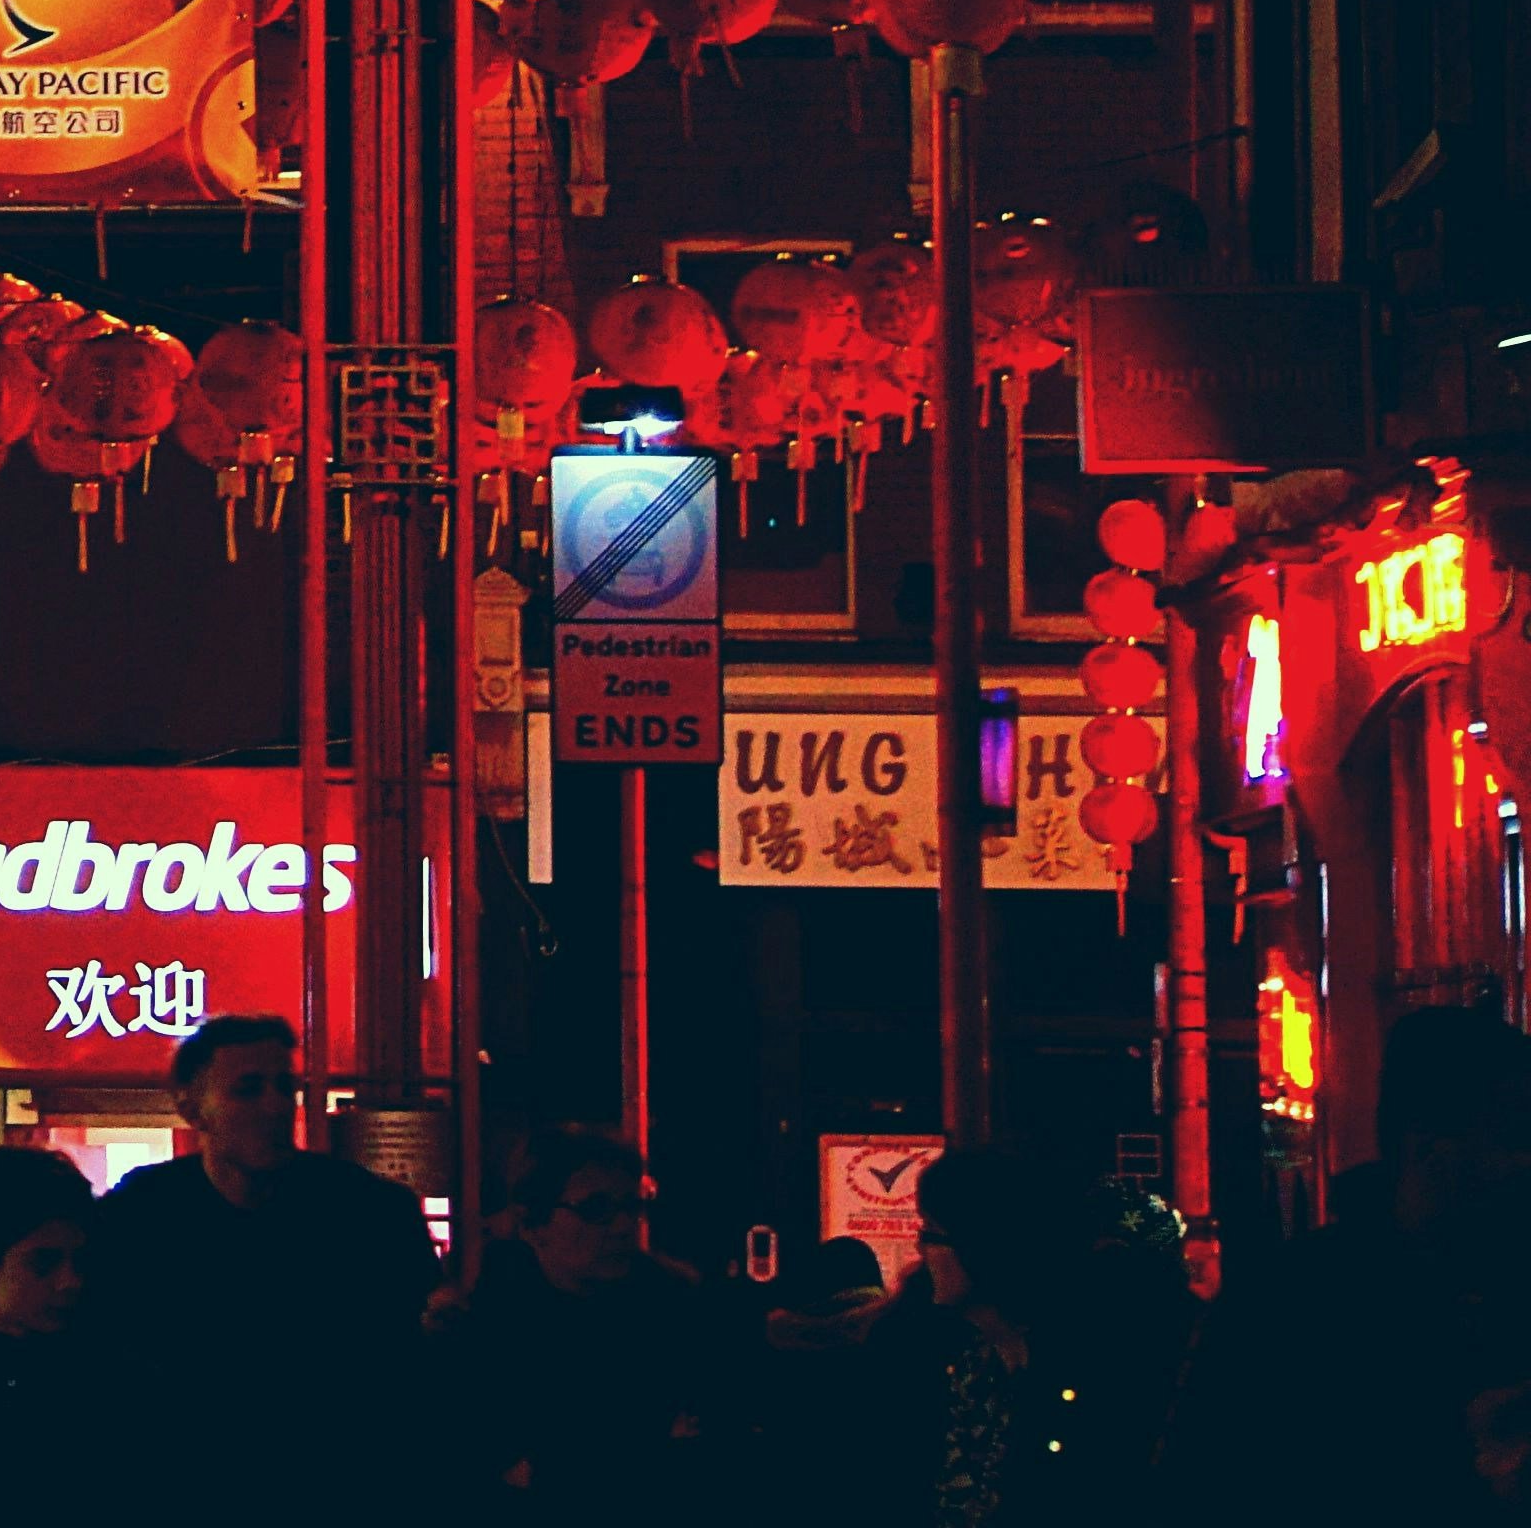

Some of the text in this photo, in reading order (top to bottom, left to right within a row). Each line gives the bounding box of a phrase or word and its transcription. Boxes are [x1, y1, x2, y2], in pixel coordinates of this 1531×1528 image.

[38, 71, 165, 96] PACIFIC
[562, 632, 712, 658] Pedestrian
[603, 673, 671, 697] Zone
[575, 713, 701, 749] ENDS
[736, 730, 908, 797] UNG
[45, 959, 207, 1040] 欢迎
